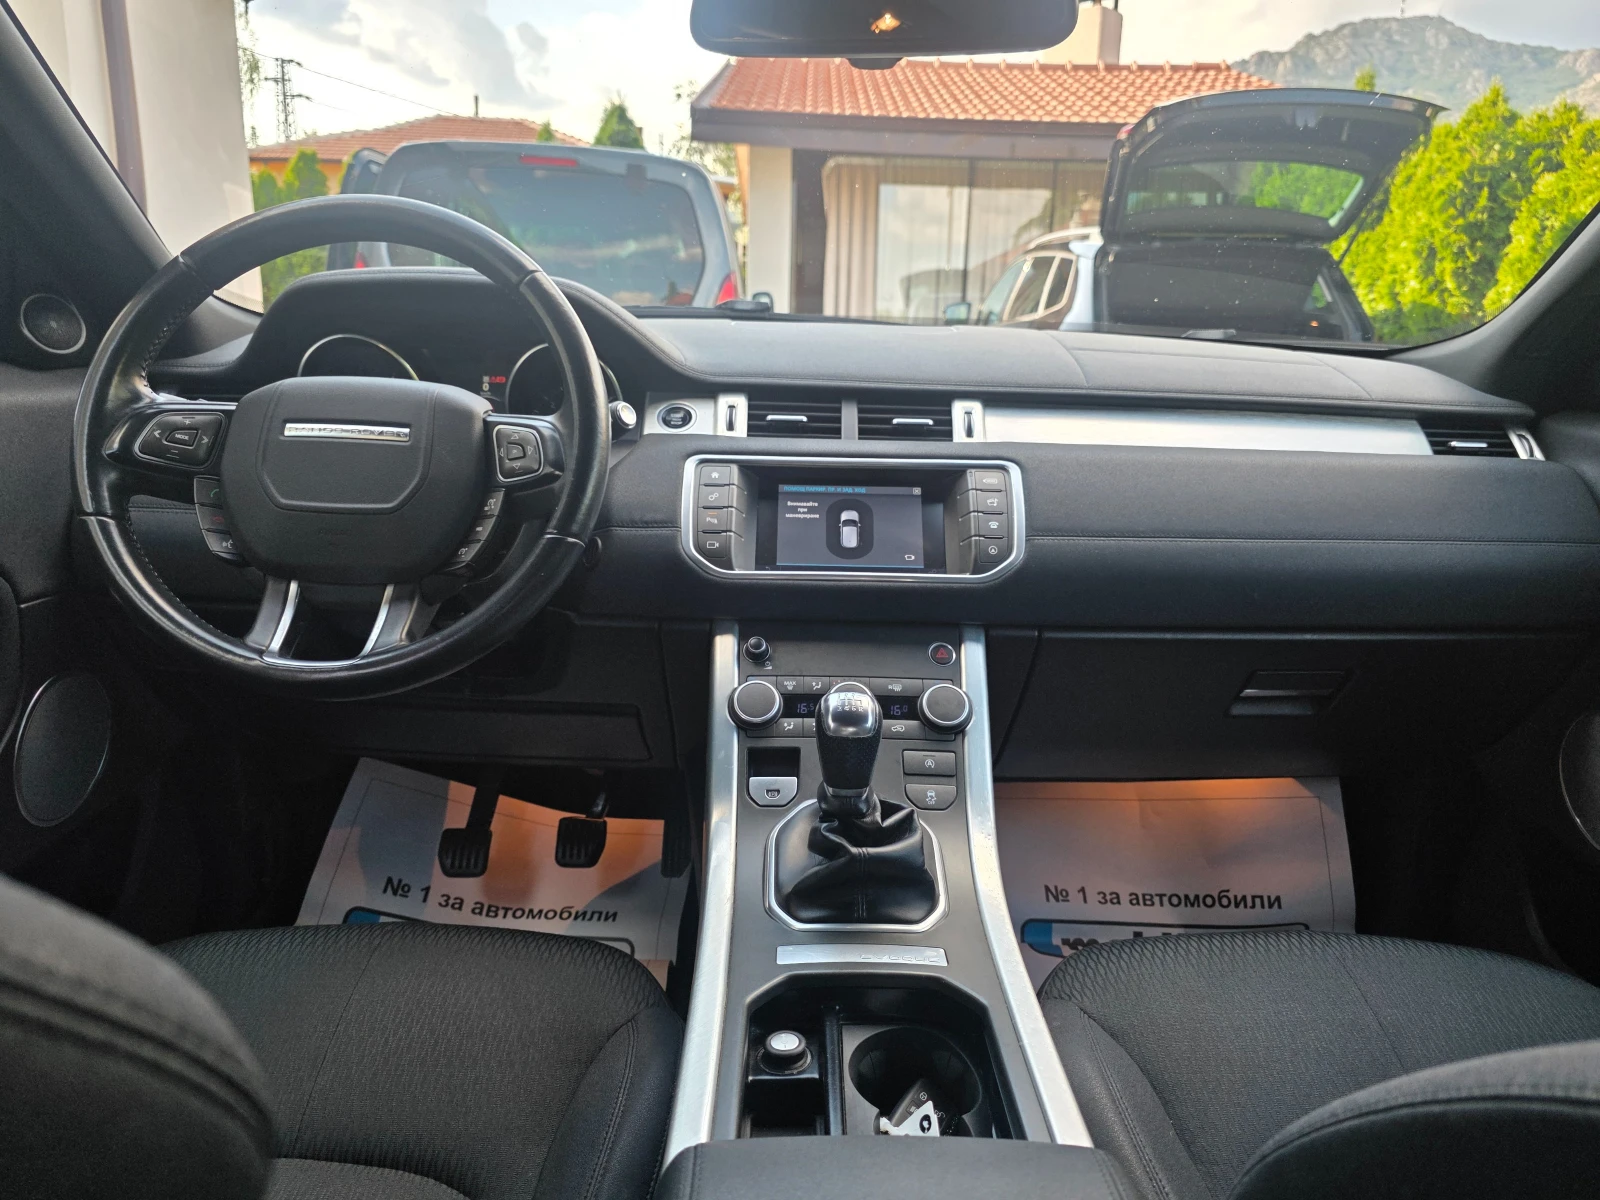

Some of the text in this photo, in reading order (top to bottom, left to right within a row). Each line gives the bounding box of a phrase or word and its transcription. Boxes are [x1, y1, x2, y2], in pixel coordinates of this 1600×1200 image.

[382, 876, 618, 923] № 1 за автомобили
[1043, 884, 1283, 910] № 1 за автомобили
